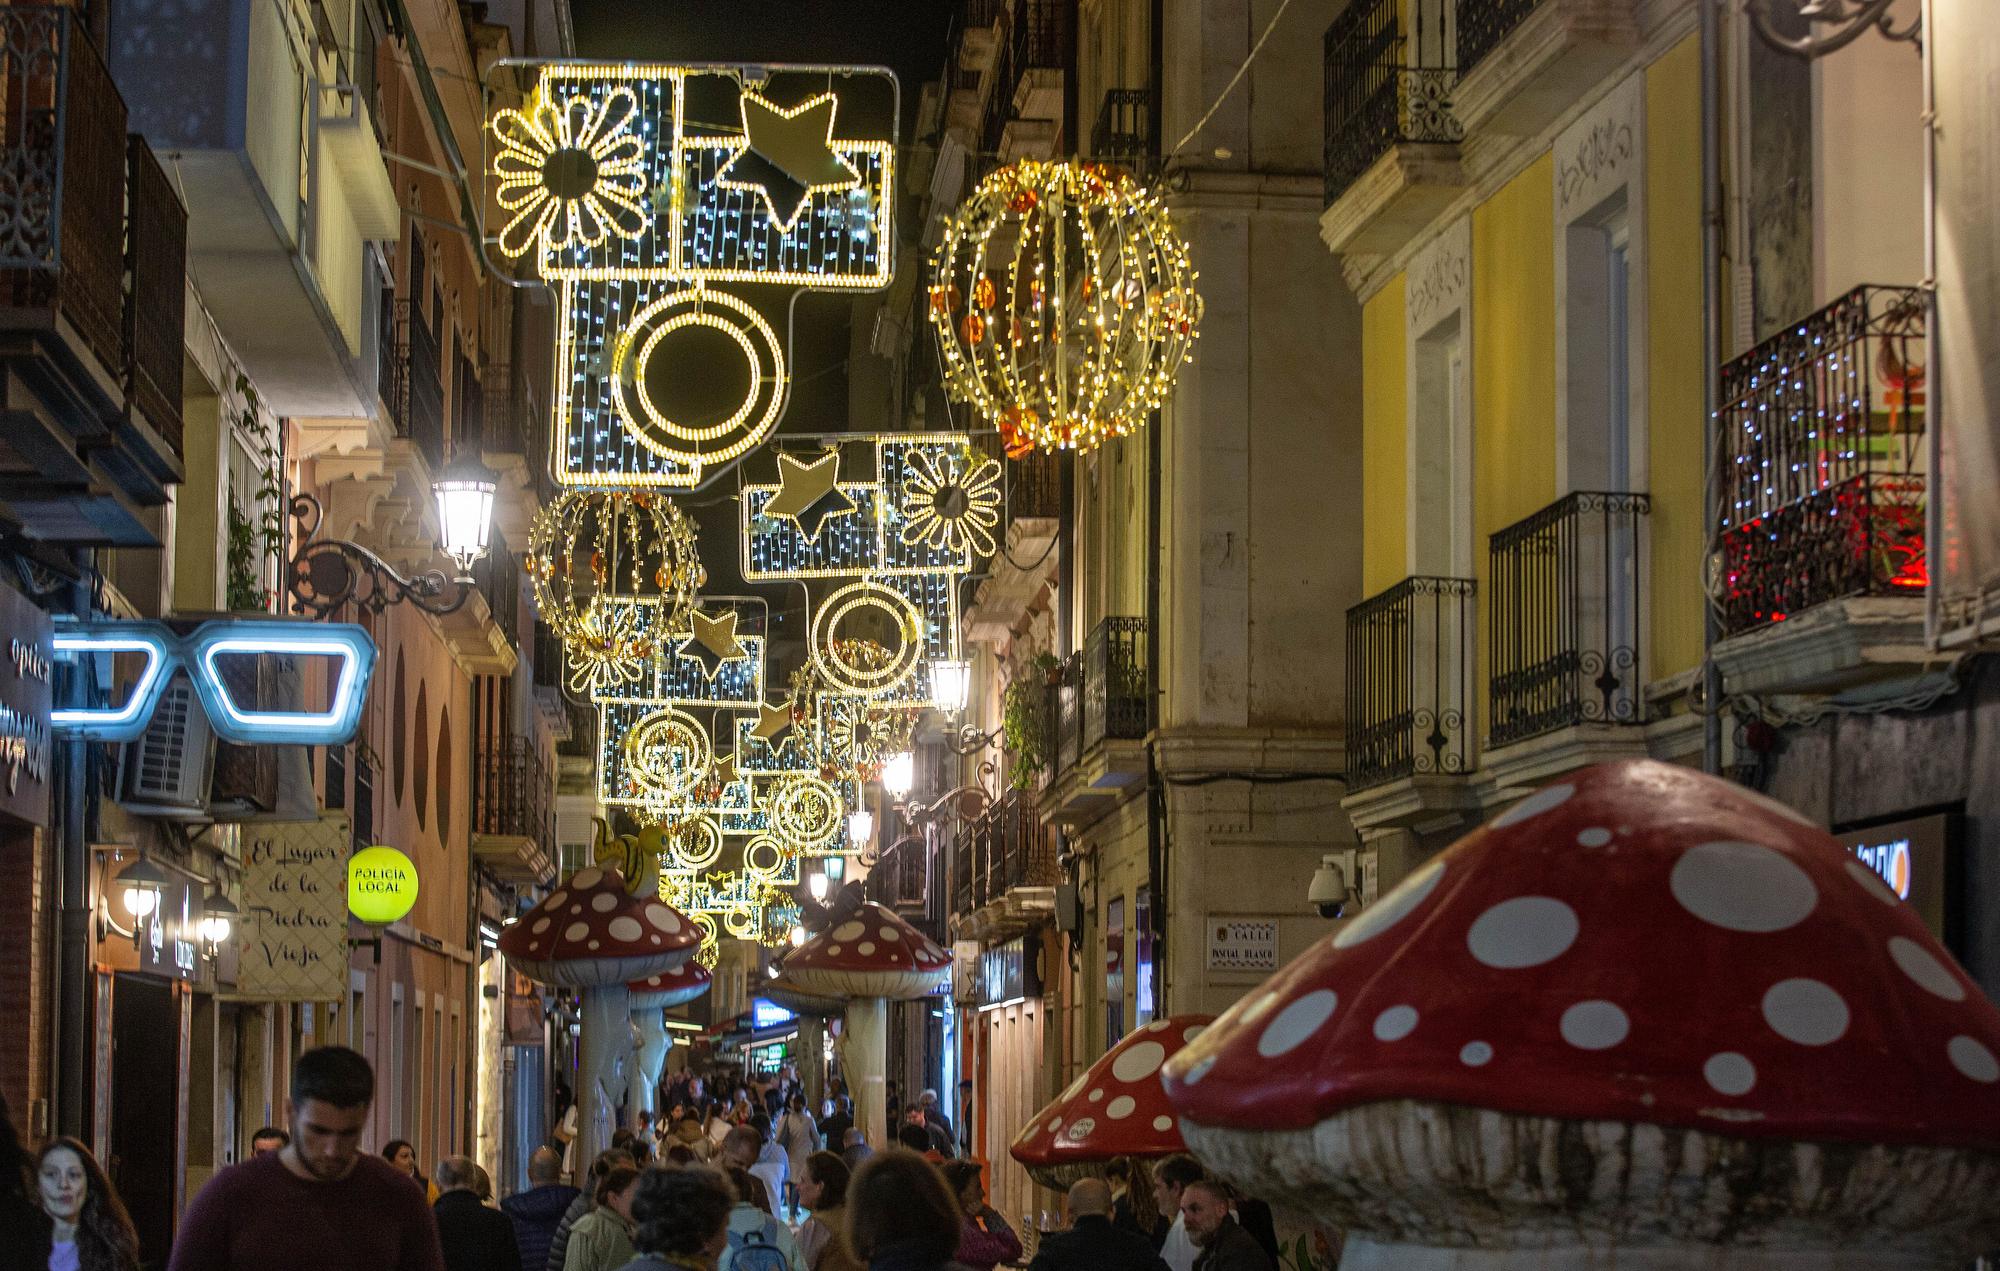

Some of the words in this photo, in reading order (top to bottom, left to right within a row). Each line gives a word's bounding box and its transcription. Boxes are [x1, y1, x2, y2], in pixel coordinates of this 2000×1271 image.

[252, 838, 274, 865] El
[275, 840, 337, 869] Lugar
[268, 872, 290, 893] de
[300, 872, 320, 893] la
[355, 867, 406, 881] POLICÍA
[358, 881, 401, 894] LOCAL
[249, 904, 329, 936] Piedra
[1234, 931, 1272, 940] CALLE
[261, 940, 321, 968] Vieja
